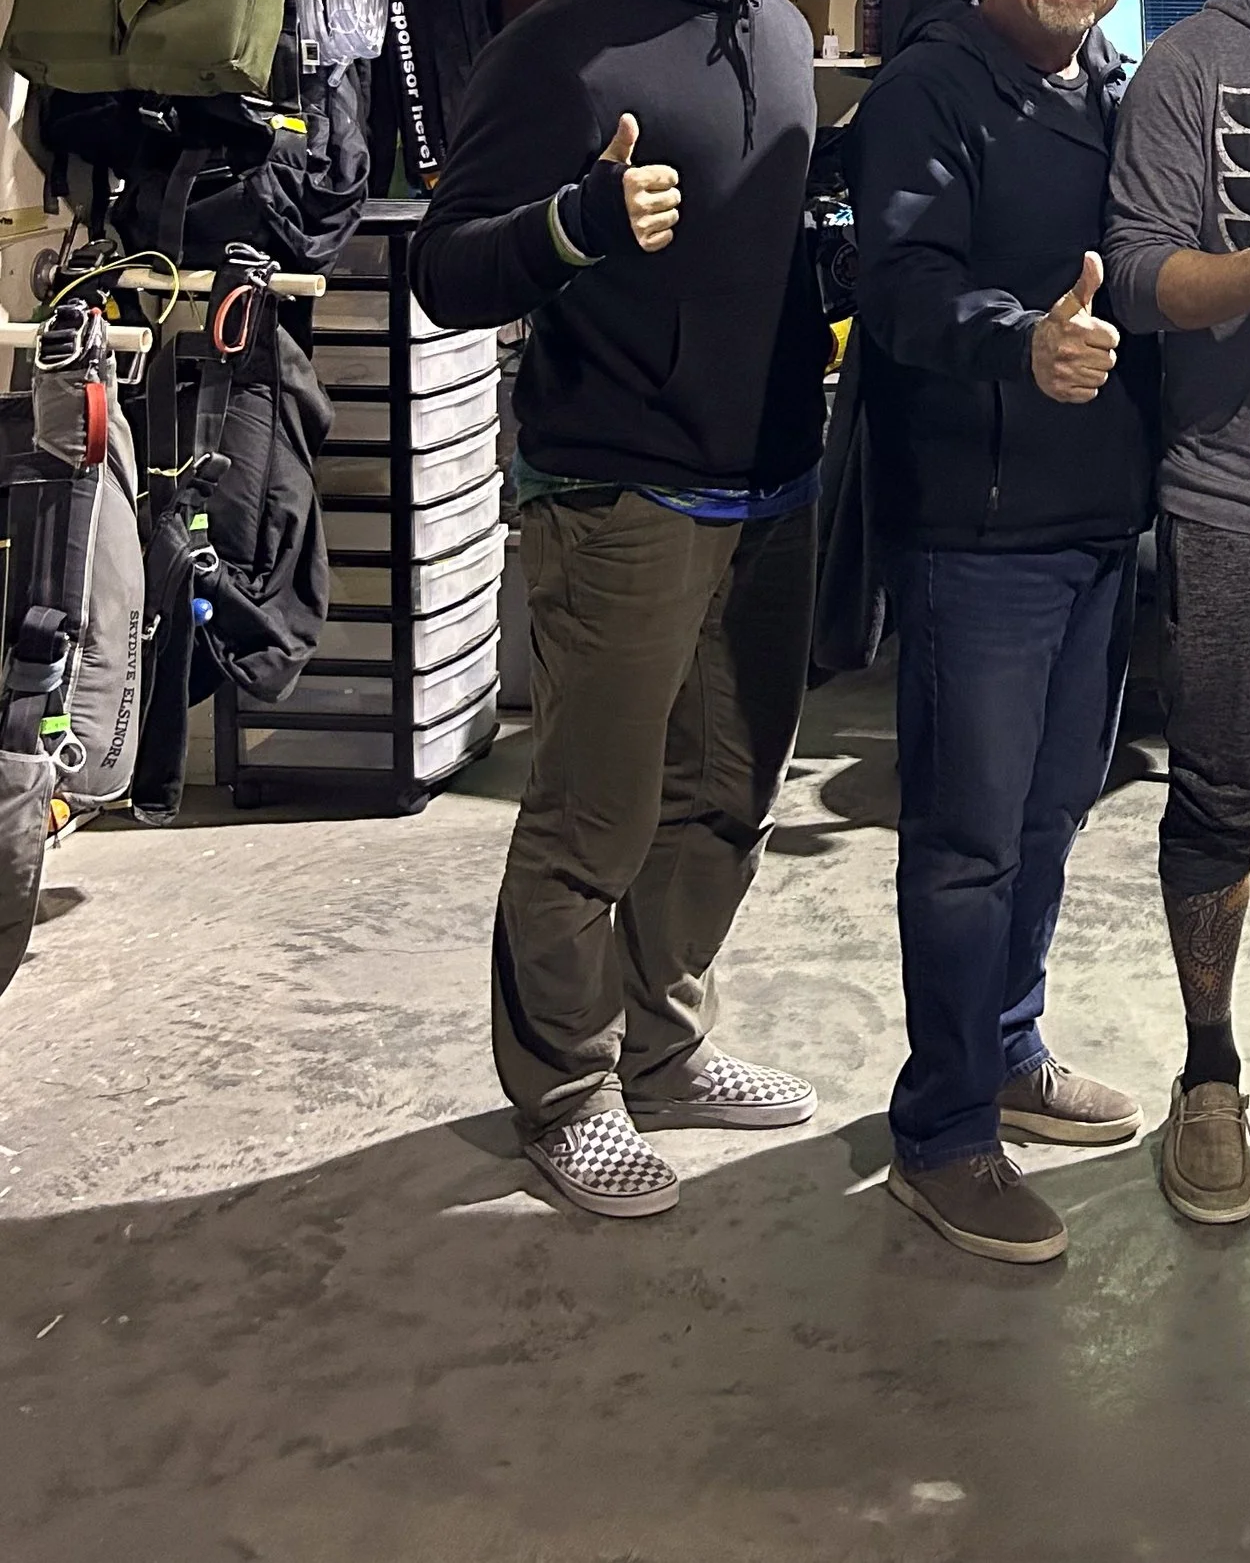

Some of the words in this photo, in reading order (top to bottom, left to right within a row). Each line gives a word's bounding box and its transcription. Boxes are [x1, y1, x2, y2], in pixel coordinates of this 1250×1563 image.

[390, 1, 420, 99] sponsor
[125, 610, 140, 681] SKYDIVE
[100, 687, 135, 769] ELSINORE
